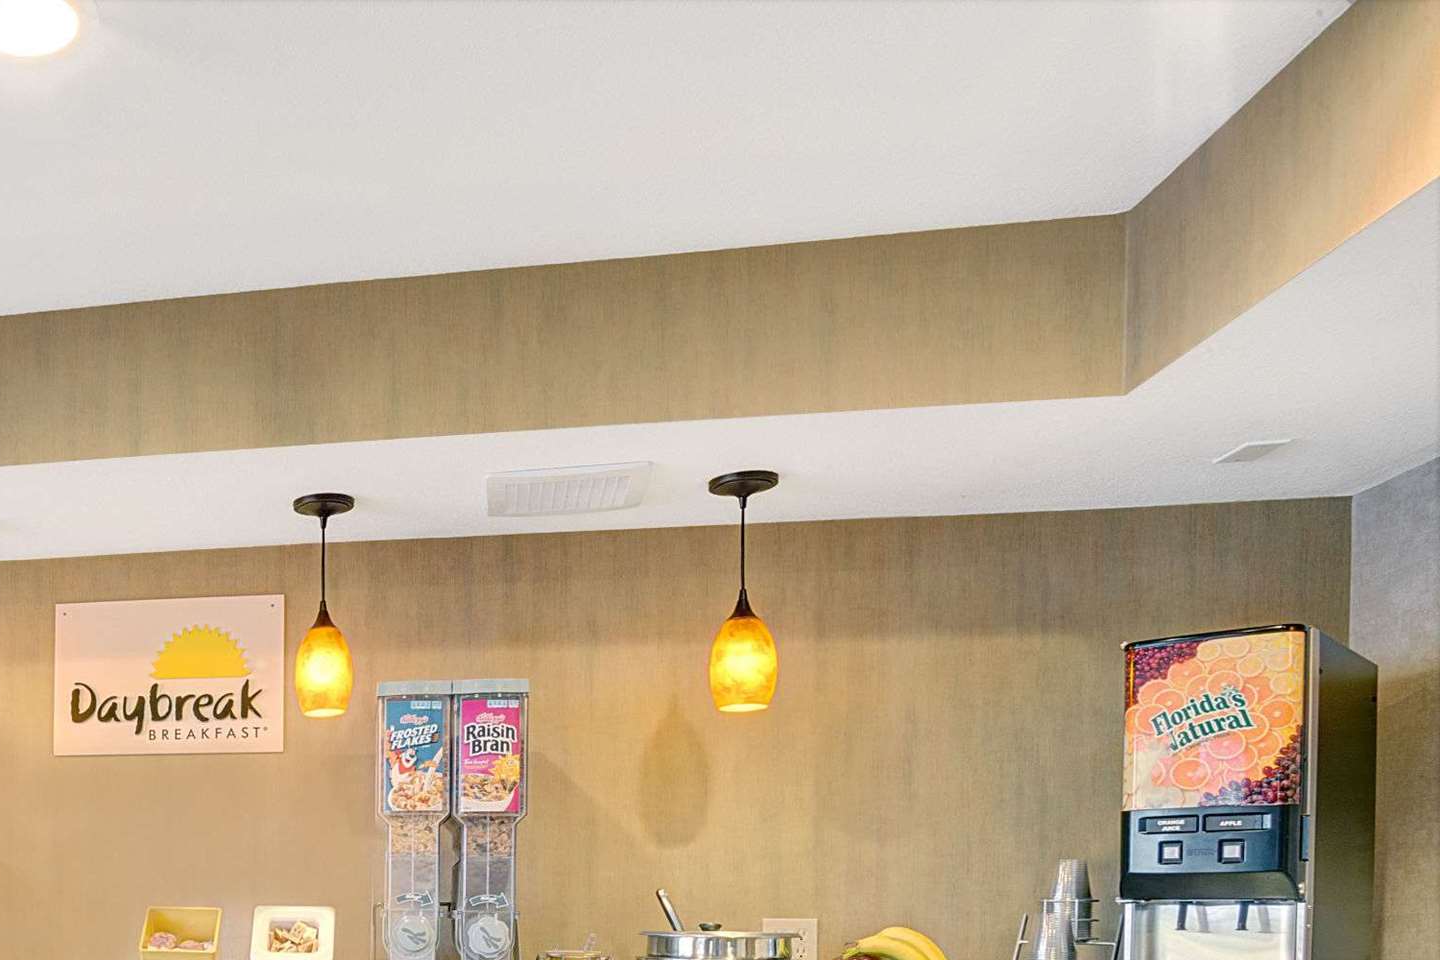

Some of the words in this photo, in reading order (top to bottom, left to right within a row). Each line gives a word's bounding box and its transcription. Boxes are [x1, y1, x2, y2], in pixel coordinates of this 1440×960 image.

[71, 679, 263, 735] Daybreak
[1151, 691, 1246, 736] Florida's
[148, 726, 262, 741] BREAKFAST
[391, 723, 438, 741] FROSTED
[465, 723, 516, 742] Raisin
[391, 734, 433, 749] FLAKES
[471, 738, 511, 754] Bran
